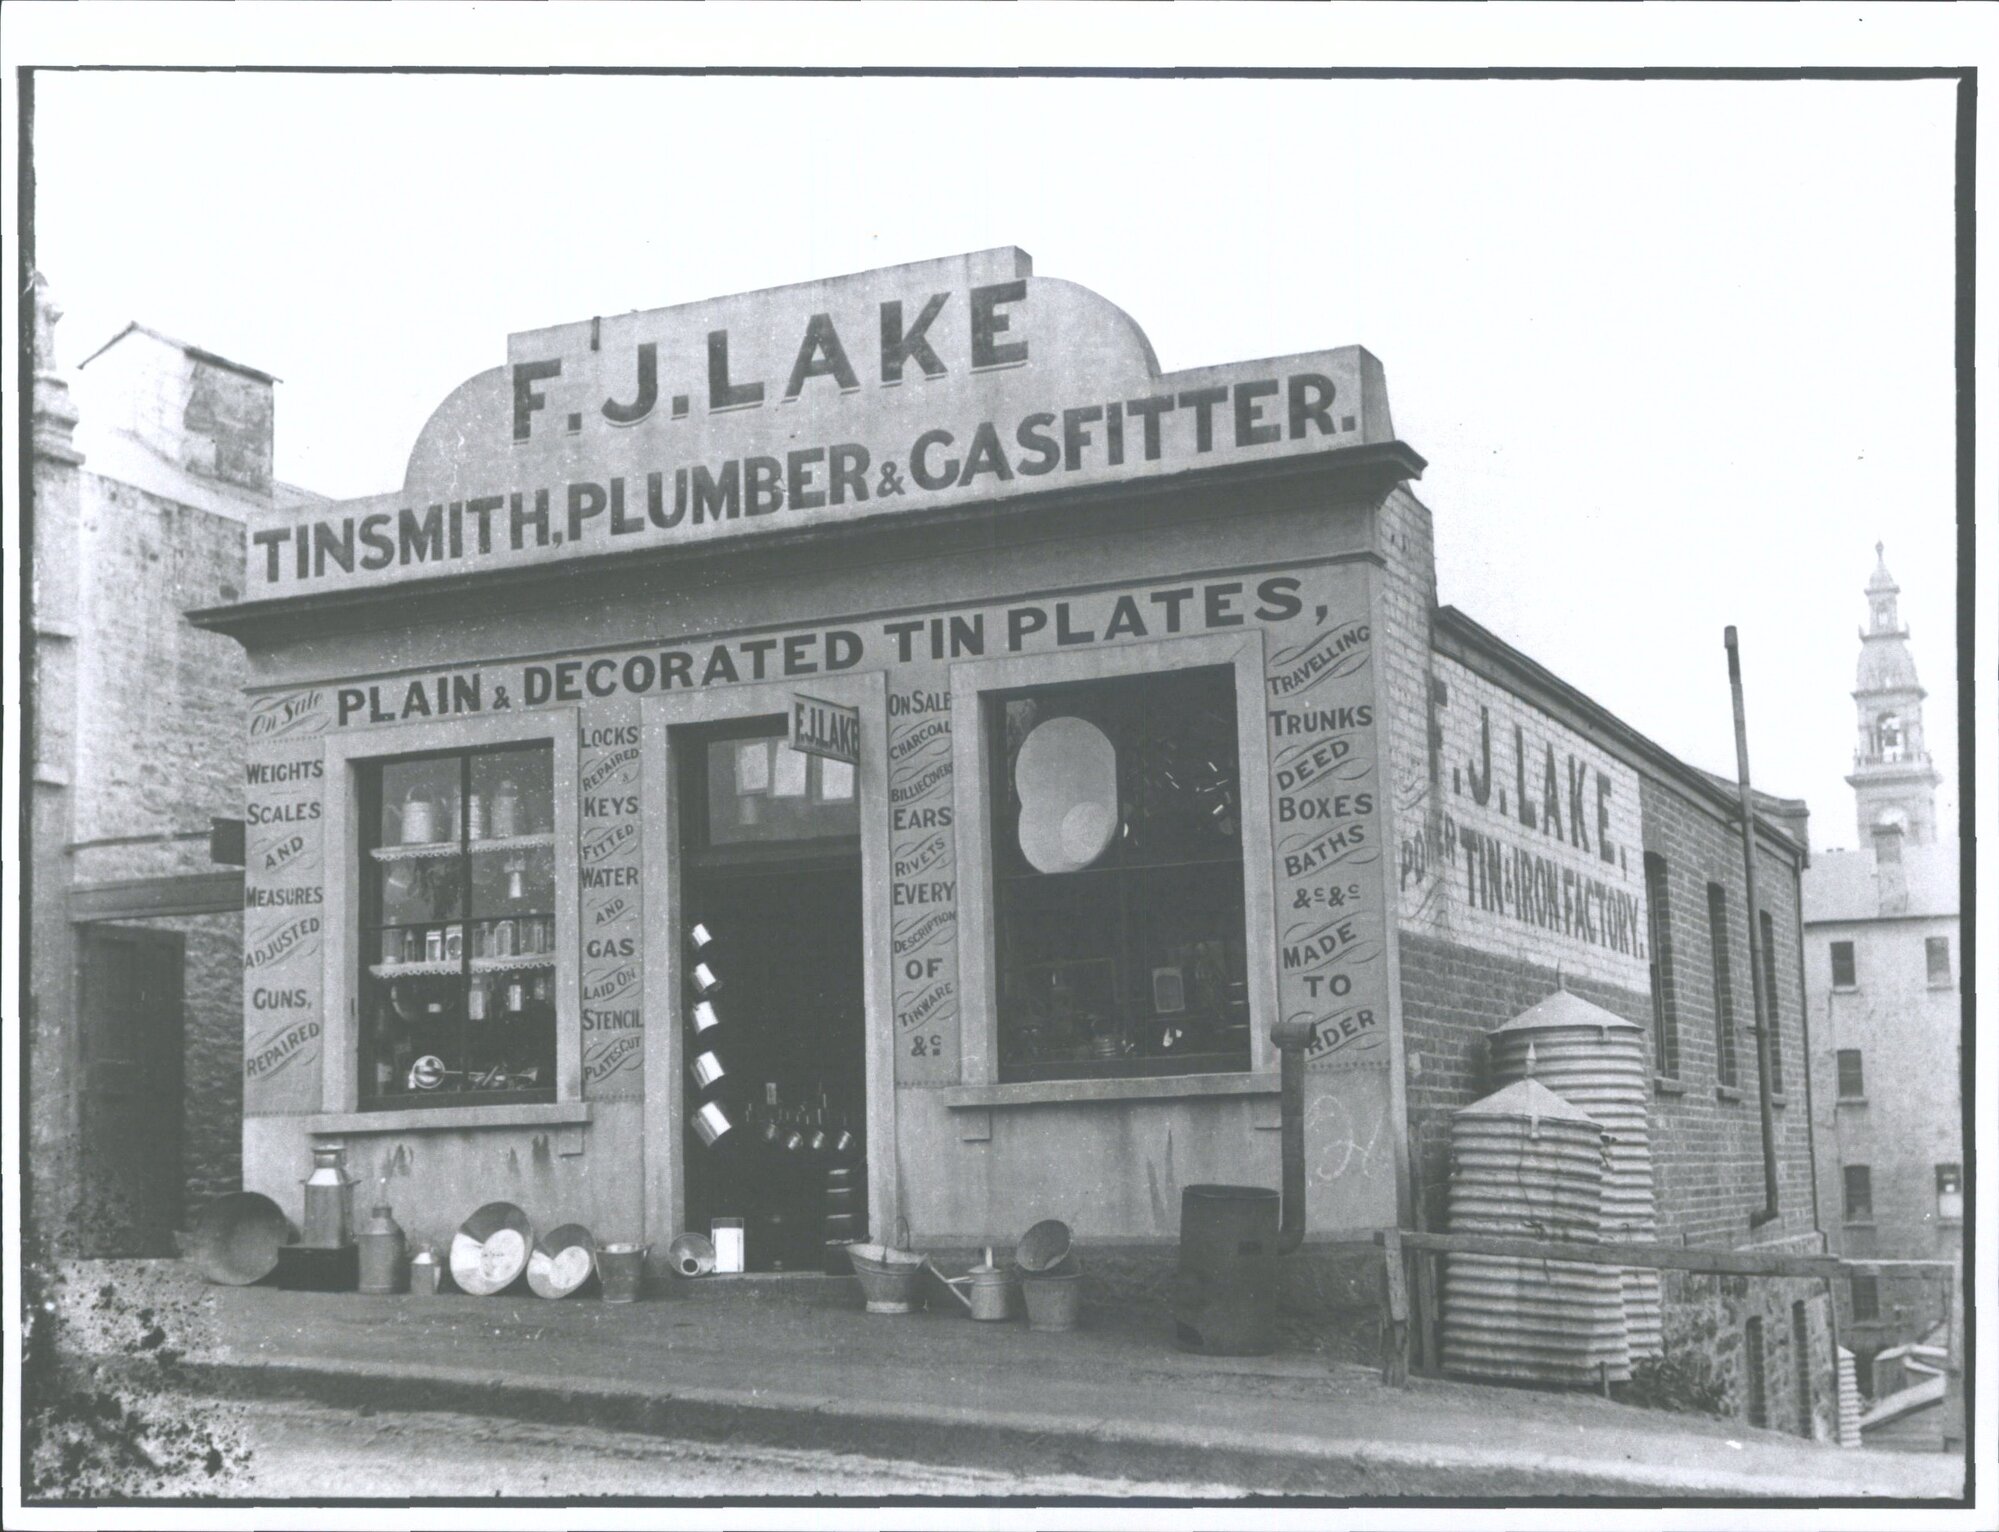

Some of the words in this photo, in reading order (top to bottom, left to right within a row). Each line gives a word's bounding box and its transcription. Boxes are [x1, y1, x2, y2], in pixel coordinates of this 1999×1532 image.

[568, 444, 870, 542] PLUMBER
[876, 460, 907, 498] &
[909, 373, 1356, 491] GASFITTER.
[337, 673, 481, 727] PLAIN
[493, 685, 511, 710] &
[523, 630, 864, 706] DECORATED
[884, 613, 985, 663] TIN
[1008, 577, 1328, 652] PLATES,
[1267, 625, 1371, 695] TRAVELLING
[580, 726, 639, 748] LOCKS
[1269, 705, 1373, 737] TRUNKS
[890, 720, 952, 761] CHARCOAL
[246, 759, 324, 785] WEIGHTS
[583, 748, 640, 792] REPAIRED
[1276, 740, 1350, 791] DEED
[246, 801, 322, 827] SCALES
[584, 796, 639, 818] KEYS
[894, 806, 953, 831] EARS
[1279, 793, 1374, 823] BOXES
[265, 836, 305, 870] AND
[583, 823, 635, 860] FITTED
[895, 837, 946, 877] RIVETS
[1284, 825, 1365, 877] BATHS
[581, 866, 639, 889] WATER
[893, 881, 957, 906] EVERY
[1460, 827, 1504, 915] TIN
[1514, 846, 1560, 933] IRON
[246, 886, 324, 908] MEASURES
[595, 899, 625, 925] AND
[244, 917, 321, 970] ADJUSTED
[586, 937, 635, 959] GAS
[894, 910, 957, 954] DESCRIPTION
[1283, 922, 1357, 970] MADE
[905, 957, 944, 980] OF
[252, 987, 313, 1010] GUNS,
[583, 981, 616, 1000] LAID
[1303, 973, 1353, 998] TO
[582, 1008, 644, 1031] STENCIL
[898, 982, 954, 1028] TINWARE
[1305, 1009, 1376, 1056] RDER
[246, 1021, 321, 1078] REPAIRED
